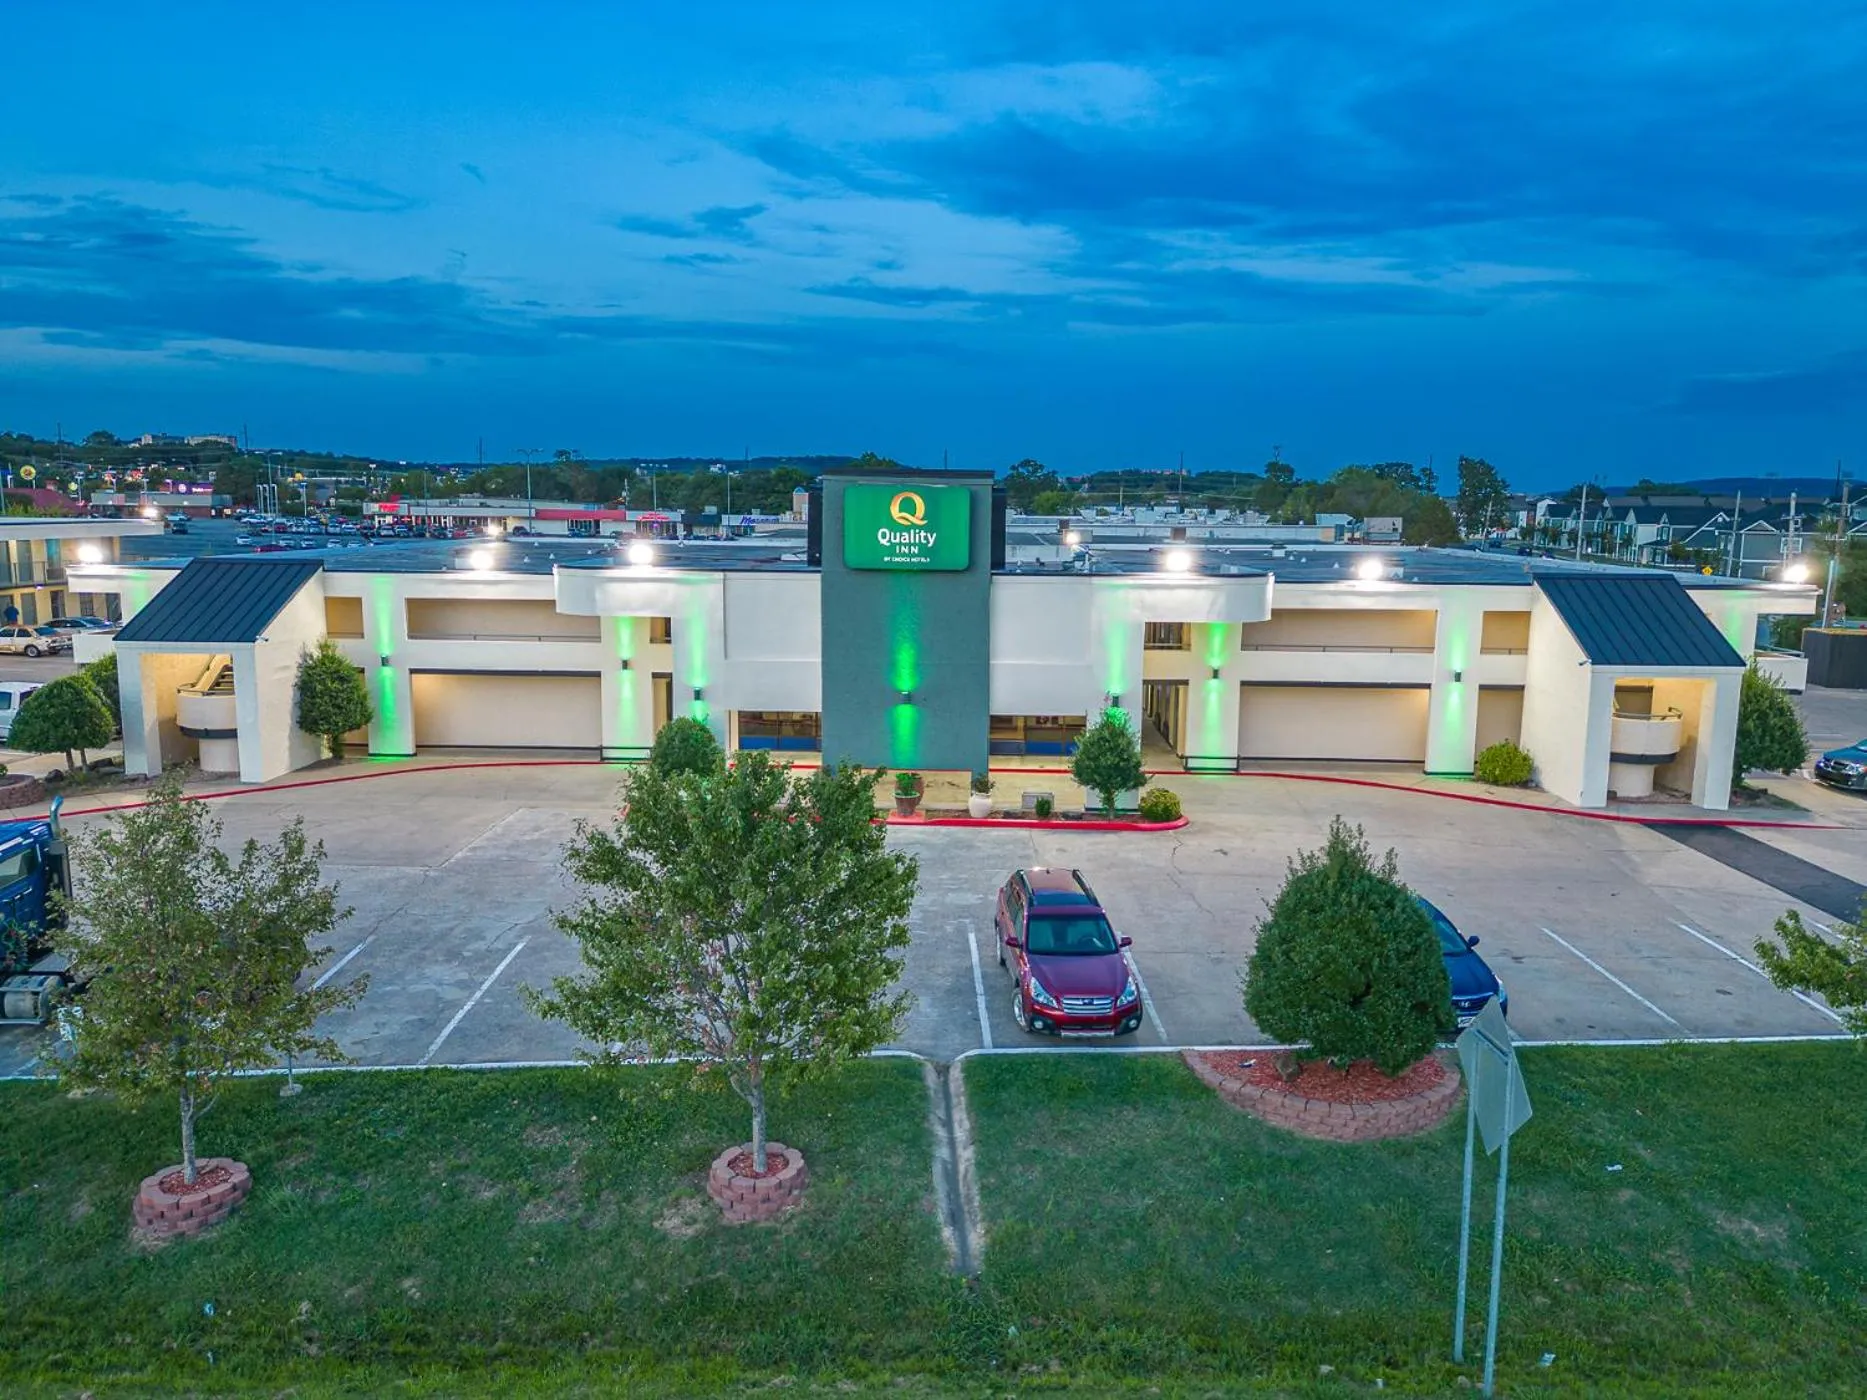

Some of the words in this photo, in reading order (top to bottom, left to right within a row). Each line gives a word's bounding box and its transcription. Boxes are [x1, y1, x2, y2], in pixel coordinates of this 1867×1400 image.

[890, 491, 928, 525] Q
[877, 528, 937, 547] Quality
[896, 545, 919, 554] INN
